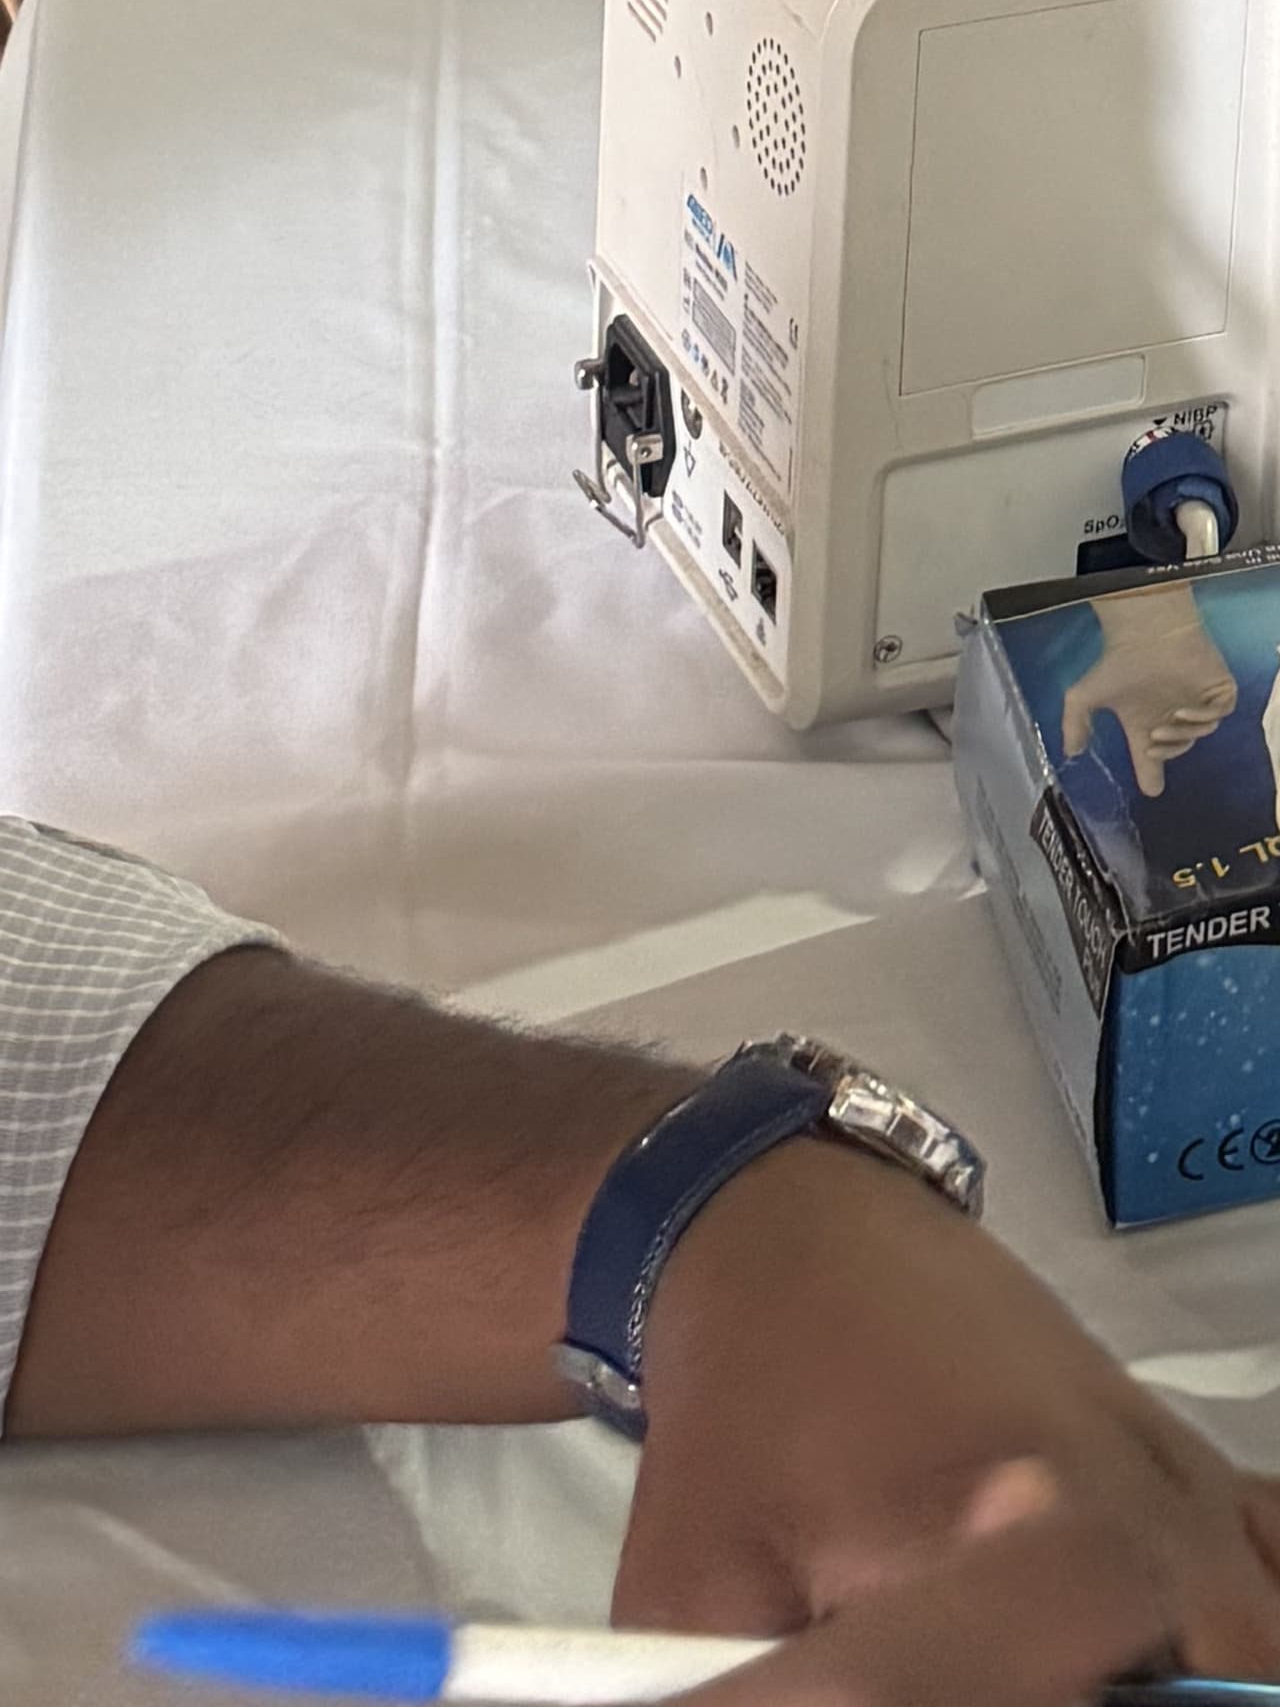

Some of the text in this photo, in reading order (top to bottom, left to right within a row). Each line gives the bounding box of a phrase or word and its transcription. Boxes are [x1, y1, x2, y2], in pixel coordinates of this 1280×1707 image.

[1174, 405, 1217, 425] NIBP
[1172, 856, 1230, 888] 1.5
[1146, 906, 1271, 959] TENDER
